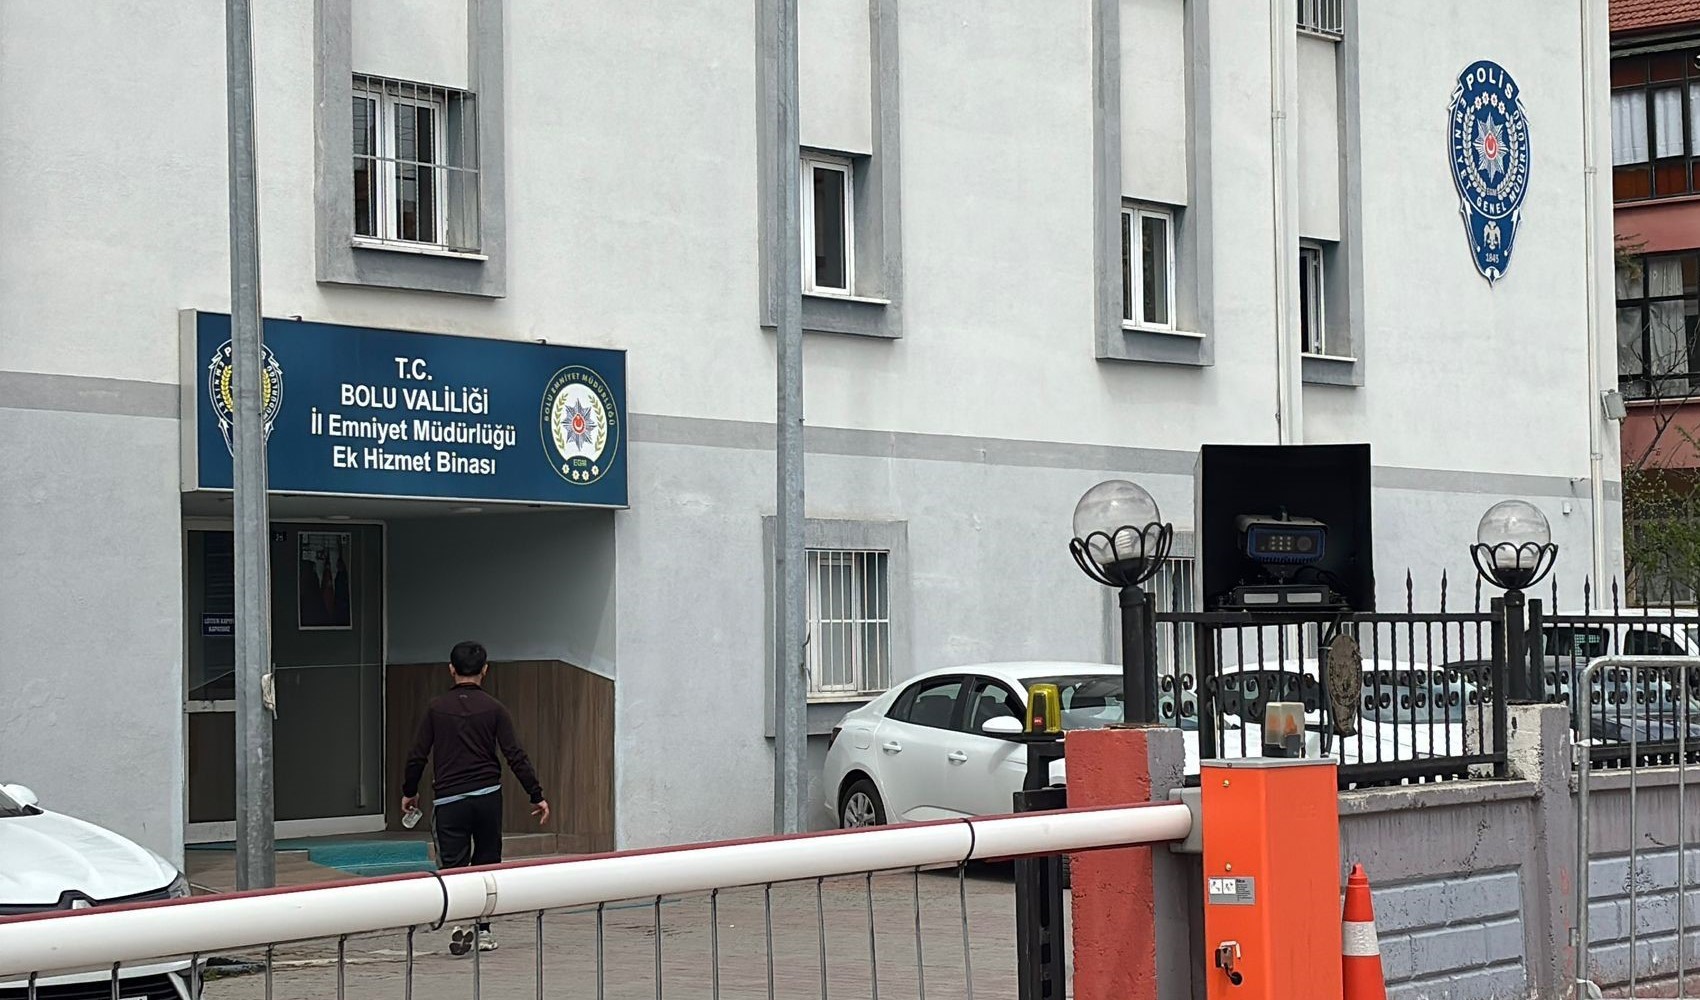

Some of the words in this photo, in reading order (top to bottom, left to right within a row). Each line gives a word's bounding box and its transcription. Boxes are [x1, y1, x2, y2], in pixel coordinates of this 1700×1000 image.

[1466, 67, 1514, 99] POLİS
[1476, 197, 1507, 214] GENEL
[1485, 252, 1500, 264] 1845
[395, 357, 433, 380] T.C.
[341, 383, 397, 409] BOLU
[402, 385, 488, 415] VALİLİĞİ
[544, 394, 553, 421] BOLU
[551, 372, 580, 394] EMNİYET
[311, 406, 322, 435] İl
[329, 413, 408, 444] Emniyet
[413, 419, 516, 451] Müdürlüğü
[333, 445, 359, 469] Ek
[364, 447, 431, 472] Hizmet
[436, 451, 496, 475] Binası
